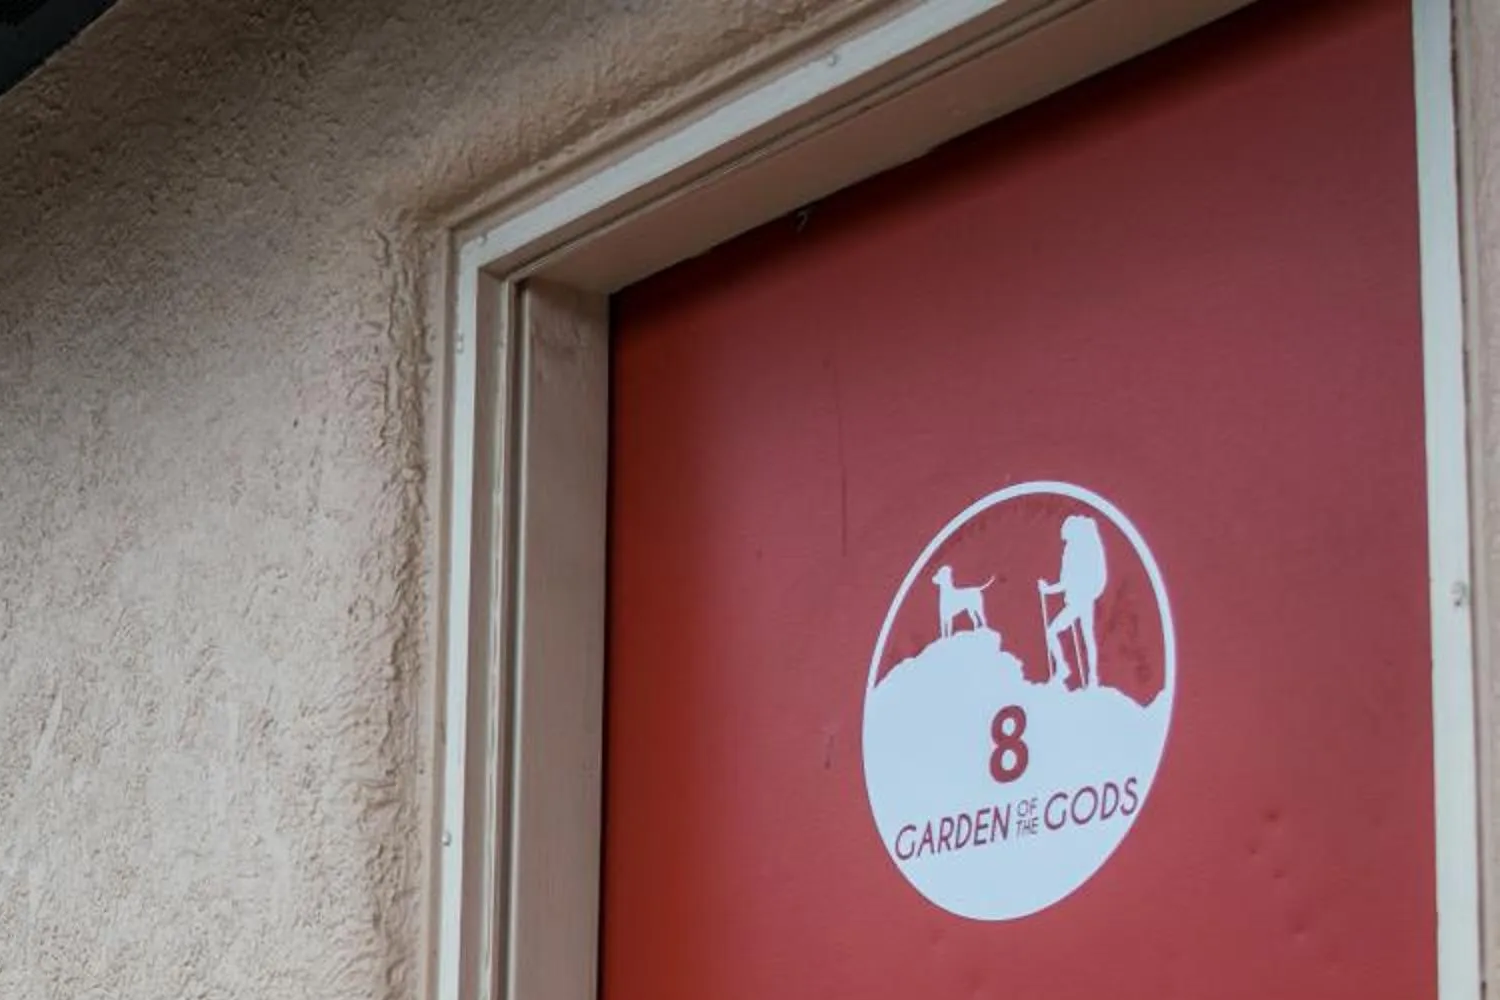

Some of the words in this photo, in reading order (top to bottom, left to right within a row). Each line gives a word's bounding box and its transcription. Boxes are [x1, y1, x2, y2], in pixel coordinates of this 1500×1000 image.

[989, 704, 1029, 783] 8
[1015, 816, 1040, 836] THE
[1016, 798, 1038, 817] OF
[1043, 776, 1138, 831] GODS
[895, 803, 1011, 861] GARDEN
